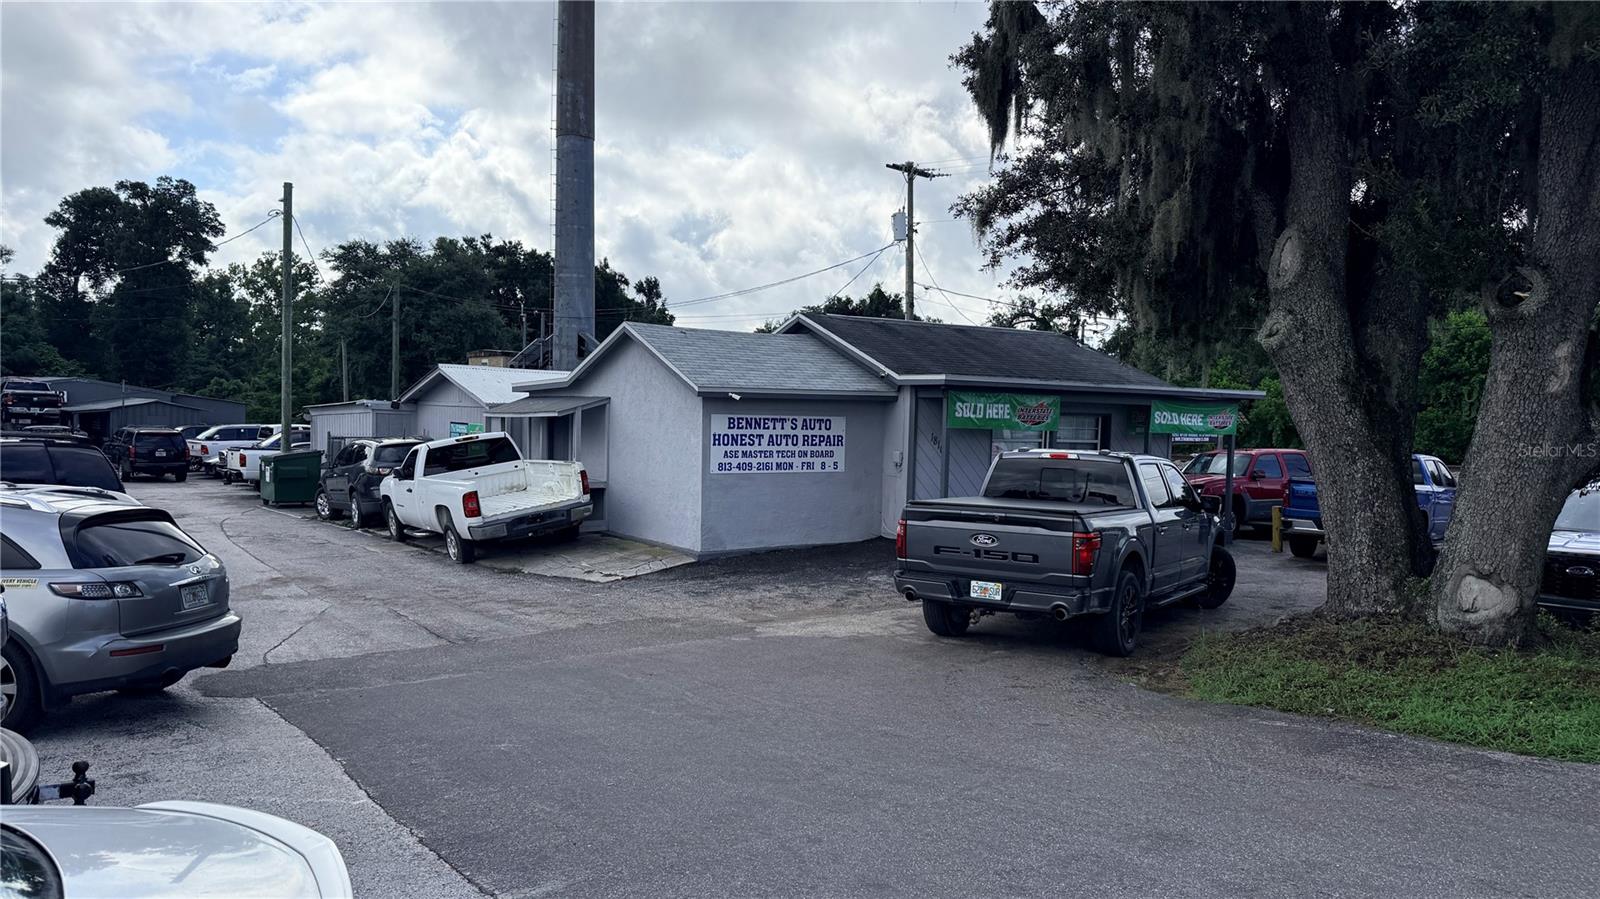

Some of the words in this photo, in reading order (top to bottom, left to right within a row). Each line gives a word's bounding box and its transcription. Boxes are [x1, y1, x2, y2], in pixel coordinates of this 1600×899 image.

[955, 402, 984, 419] SOLD
[986, 403, 1011, 419] HERE
[727, 416, 798, 430] BENNETT'S
[801, 418, 832, 431] AUTO
[1154, 411, 1179, 425] SOLD
[1180, 413, 1204, 426] HERE
[712, 433, 764, 447] HONEST
[767, 434, 799, 447] AUTO
[802, 434, 844, 447] REPAIR
[723, 450, 739, 459] ASE
[741, 450, 774, 459] MASTER
[775, 450, 796, 459] TECH
[797, 450, 808, 459] ON
[809, 450, 835, 458] BOARD
[717, 462, 774, 472] 813-409-2161
[775, 462, 794, 471] MON
[801, 462, 815, 471] FRI
[820, 462, 826, 471] 8
[832, 462, 839, 470] 5
[976, 534, 993, 544] Ford
[933, 545, 1040, 564] F-150
